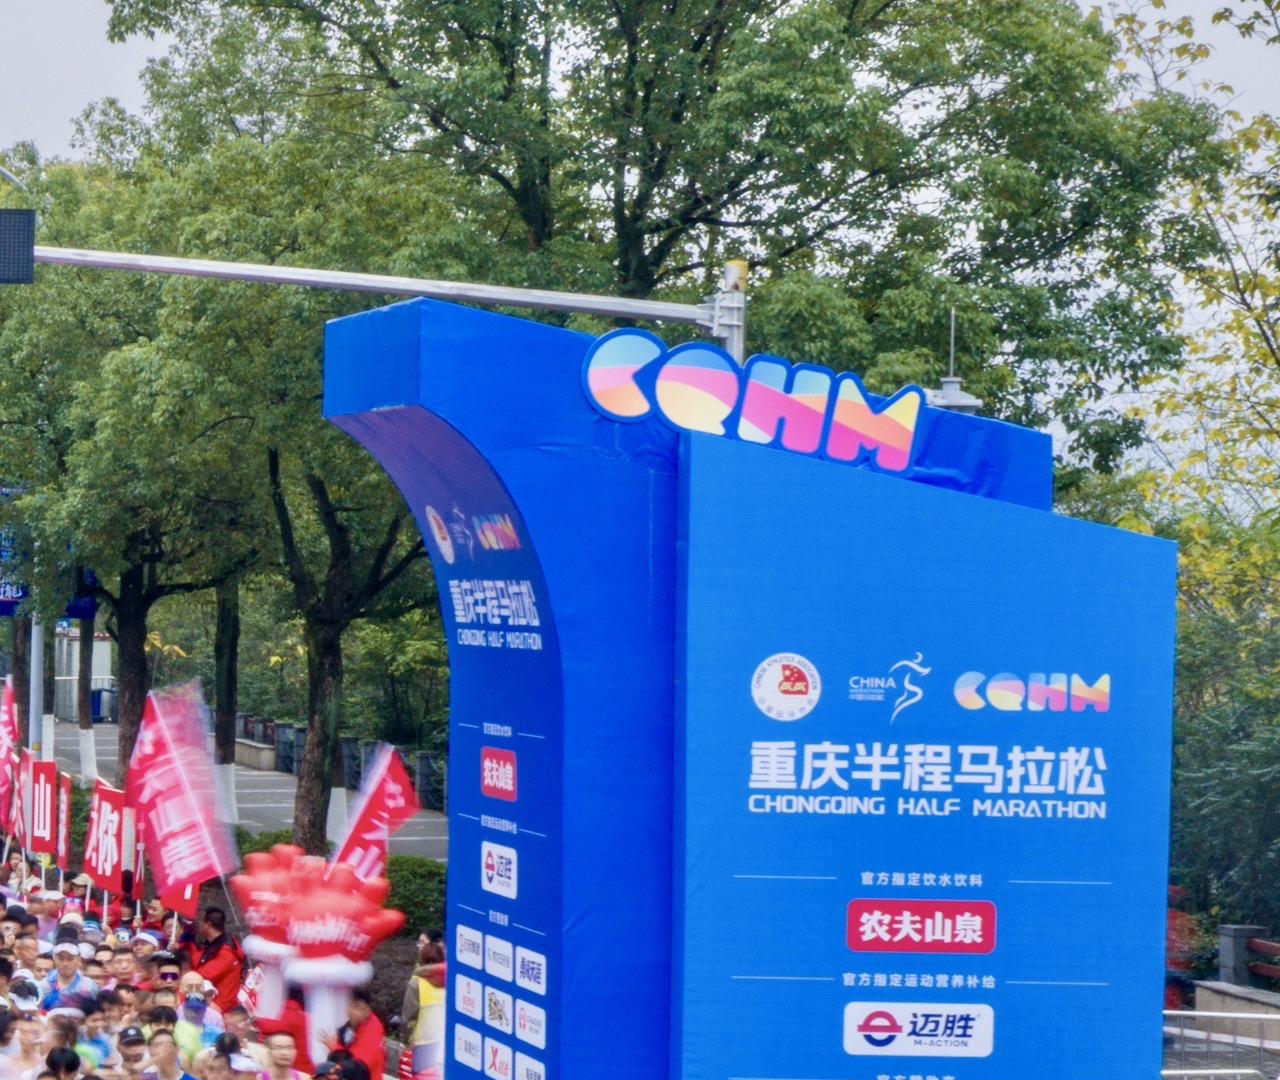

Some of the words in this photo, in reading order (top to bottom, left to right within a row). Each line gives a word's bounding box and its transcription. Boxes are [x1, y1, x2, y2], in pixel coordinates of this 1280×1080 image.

[587, 332, 920, 472] CQHM
[849, 676, 896, 688] CHINA
[953, 671, 1111, 713] CQHM
[748, 741, 1108, 795] 重庆半程马拉松
[748, 795, 885, 815] CHONGQING
[897, 797, 961, 816] HALF
[973, 799, 1106, 819] MARATHON
[861, 872, 983, 886] 官方指定饮水饮料
[859, 911, 984, 944] 农夫山泉
[843, 973, 995, 988] 官方指定运动营养补给
[907, 1012, 975, 1038] 迈胜
[913, 1038, 969, 1048] M-ACTION
